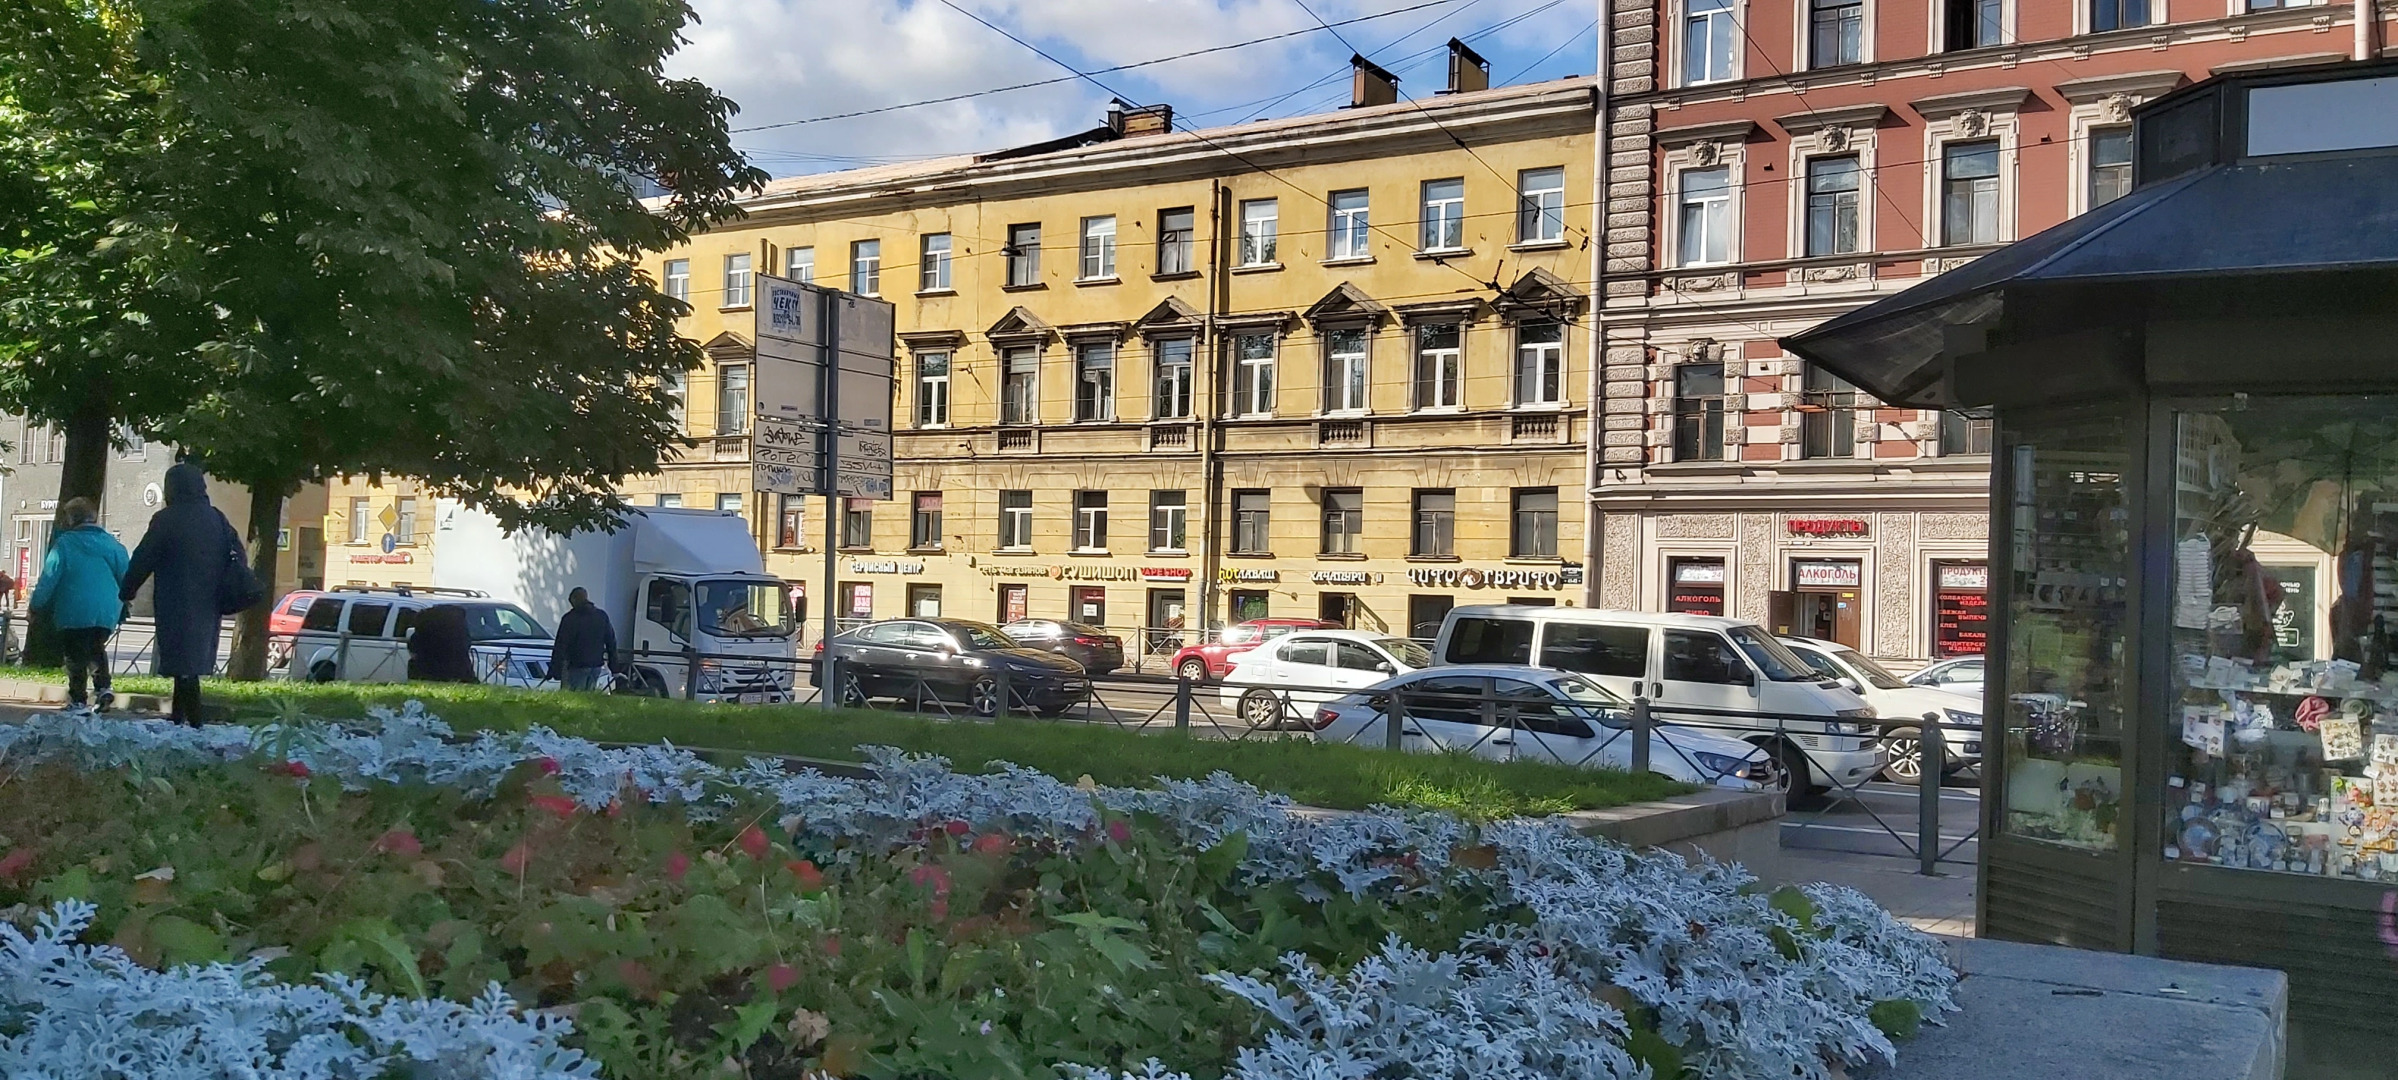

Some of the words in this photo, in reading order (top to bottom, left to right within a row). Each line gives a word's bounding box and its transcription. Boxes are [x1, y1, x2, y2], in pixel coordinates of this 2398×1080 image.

[773, 296, 798, 310] ЧЕКИ
[40, 500, 59, 509] БУРГ
[1788, 519, 1864, 533] ПРОДУКТЫ
[851, 561, 896, 574] СЕРВИСНЫЙ
[897, 562, 924, 575] ЦЕНТР
[1062, 565, 1133, 579] СУШИШОП
[1164, 568, 1191, 577] SHOP
[1799, 568, 1857, 579] АЛКОГОЛЬ
[1309, 571, 1366, 582] ХАЧАПУРИ
[1405, 568, 1456, 584] ЧИТО
[1482, 570, 1558, 586] ГВРИТО
[1675, 595, 1721, 603] АЛКОГОЛЬ
